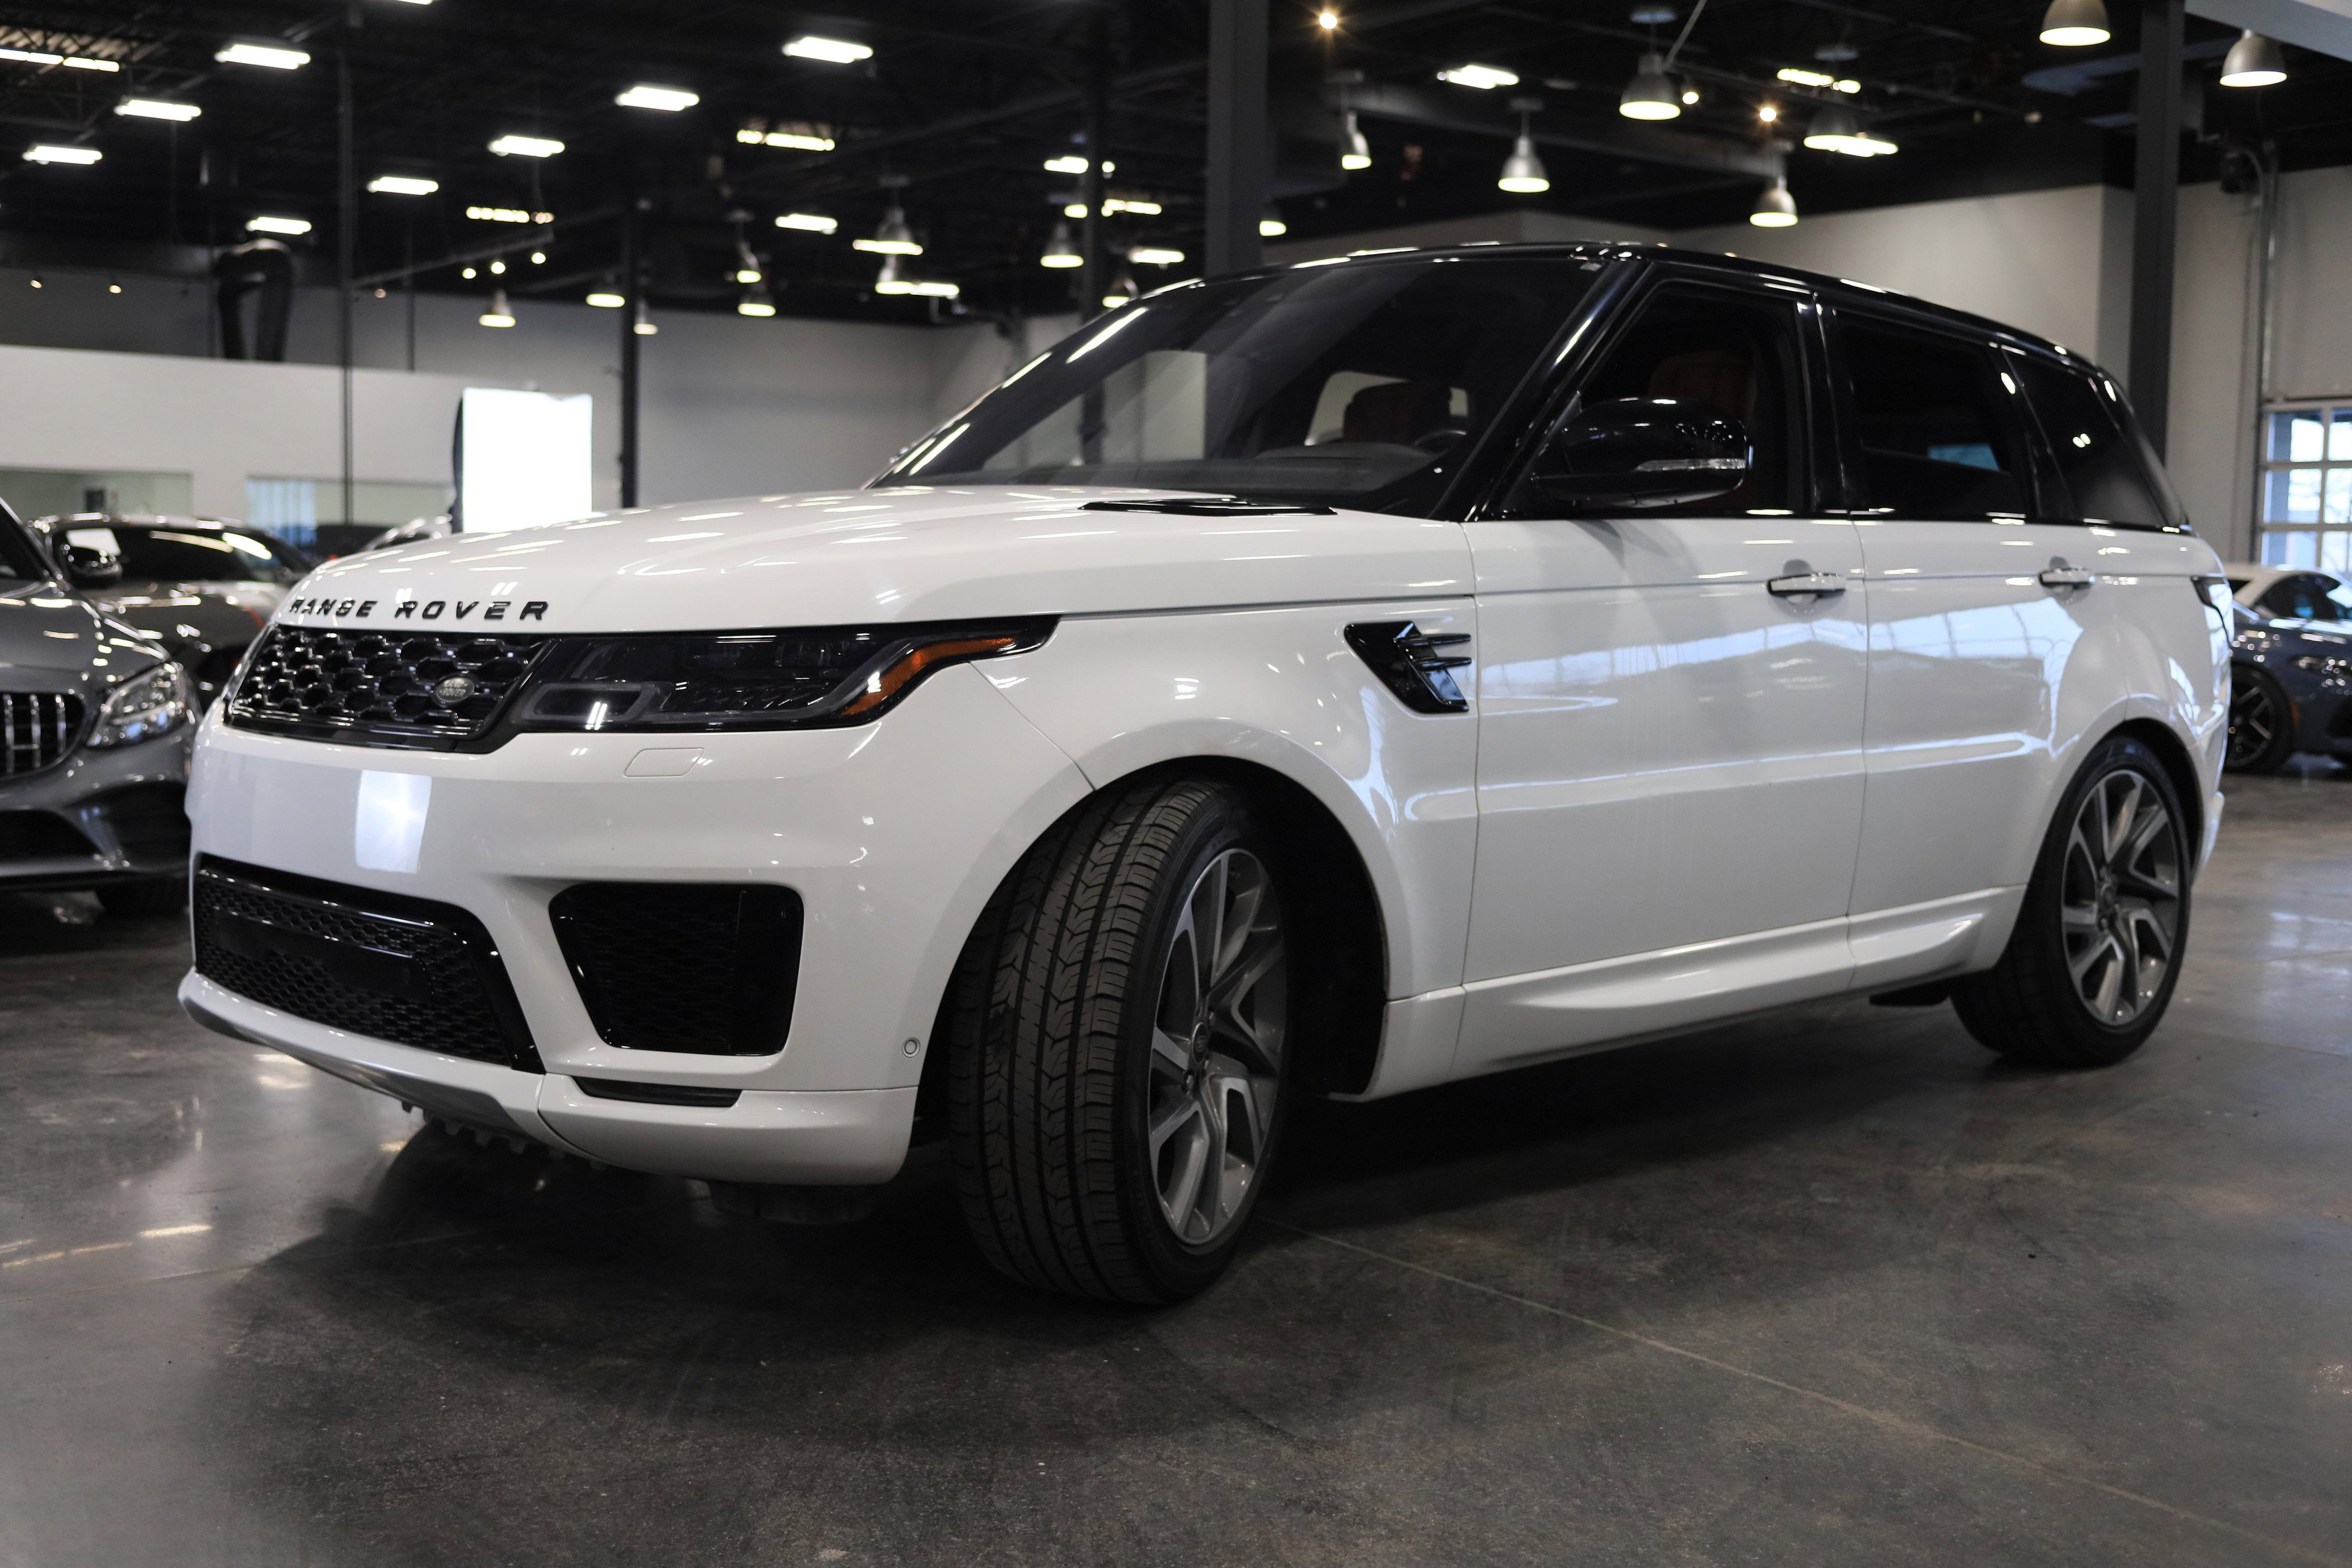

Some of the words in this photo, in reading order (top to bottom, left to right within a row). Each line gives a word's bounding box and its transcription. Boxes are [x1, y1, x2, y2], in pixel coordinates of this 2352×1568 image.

[289, 598, 379, 617] RANGE
[394, 601, 548, 620] ROVER
[443, 679, 465, 688] LAND
[441, 688, 466, 697] ROVER
